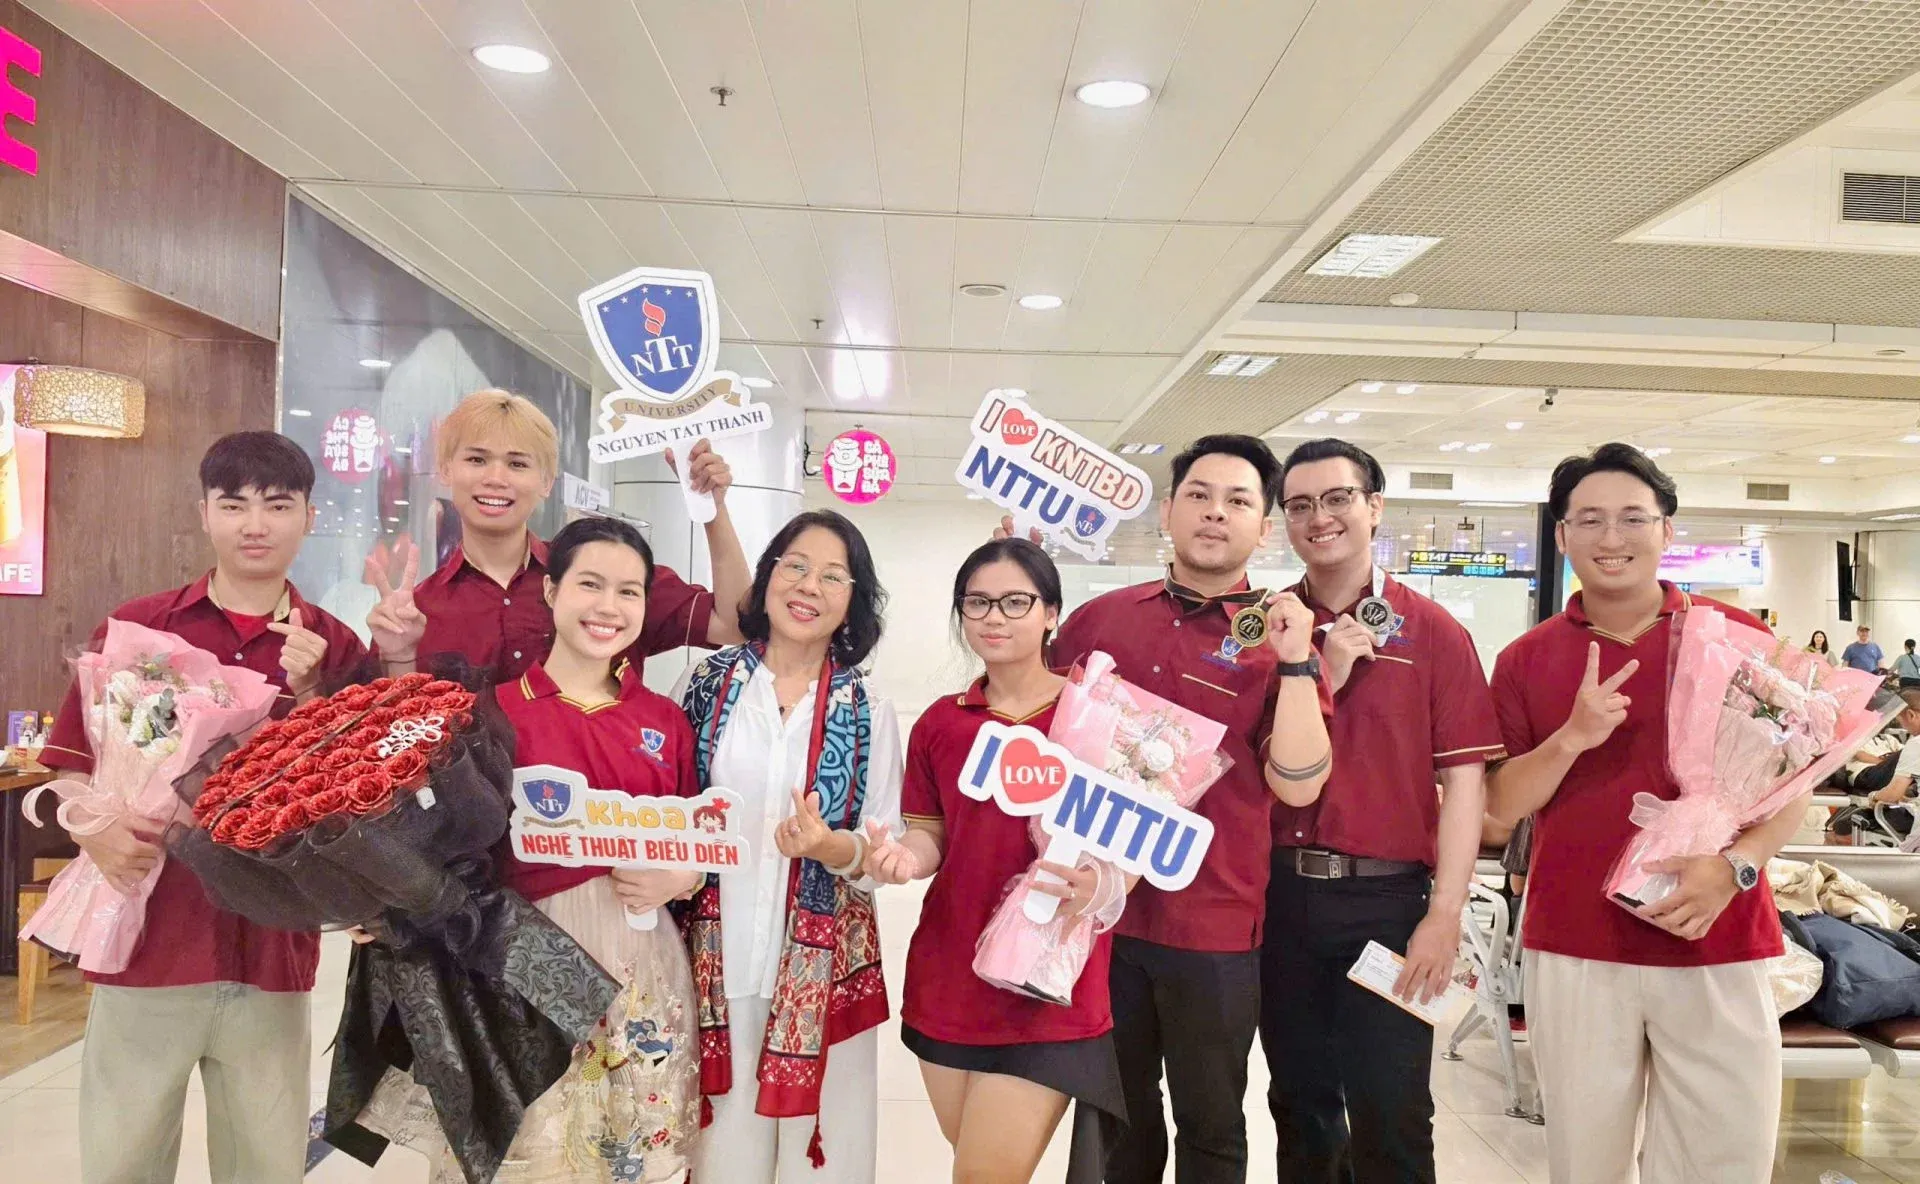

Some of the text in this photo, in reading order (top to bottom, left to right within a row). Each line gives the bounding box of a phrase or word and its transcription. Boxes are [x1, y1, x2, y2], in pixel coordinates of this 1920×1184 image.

[631, 335, 693, 377] NTT
[624, 386, 717, 418] UNIVERSITY
[597, 410, 764, 456] NGUYEN TAT THANH
[980, 398, 1144, 511] I LOVE KNTBD
[965, 445, 1075, 525] NTTU
[0, 563, 33, 583] FE
[535, 798, 566, 813] NTT
[585, 799, 687, 830] Khoa
[971, 735, 1198, 877] I LOVE NTTU
[521, 831, 739, 866] NGHỆ THUẬT BIỂU DIỄN
